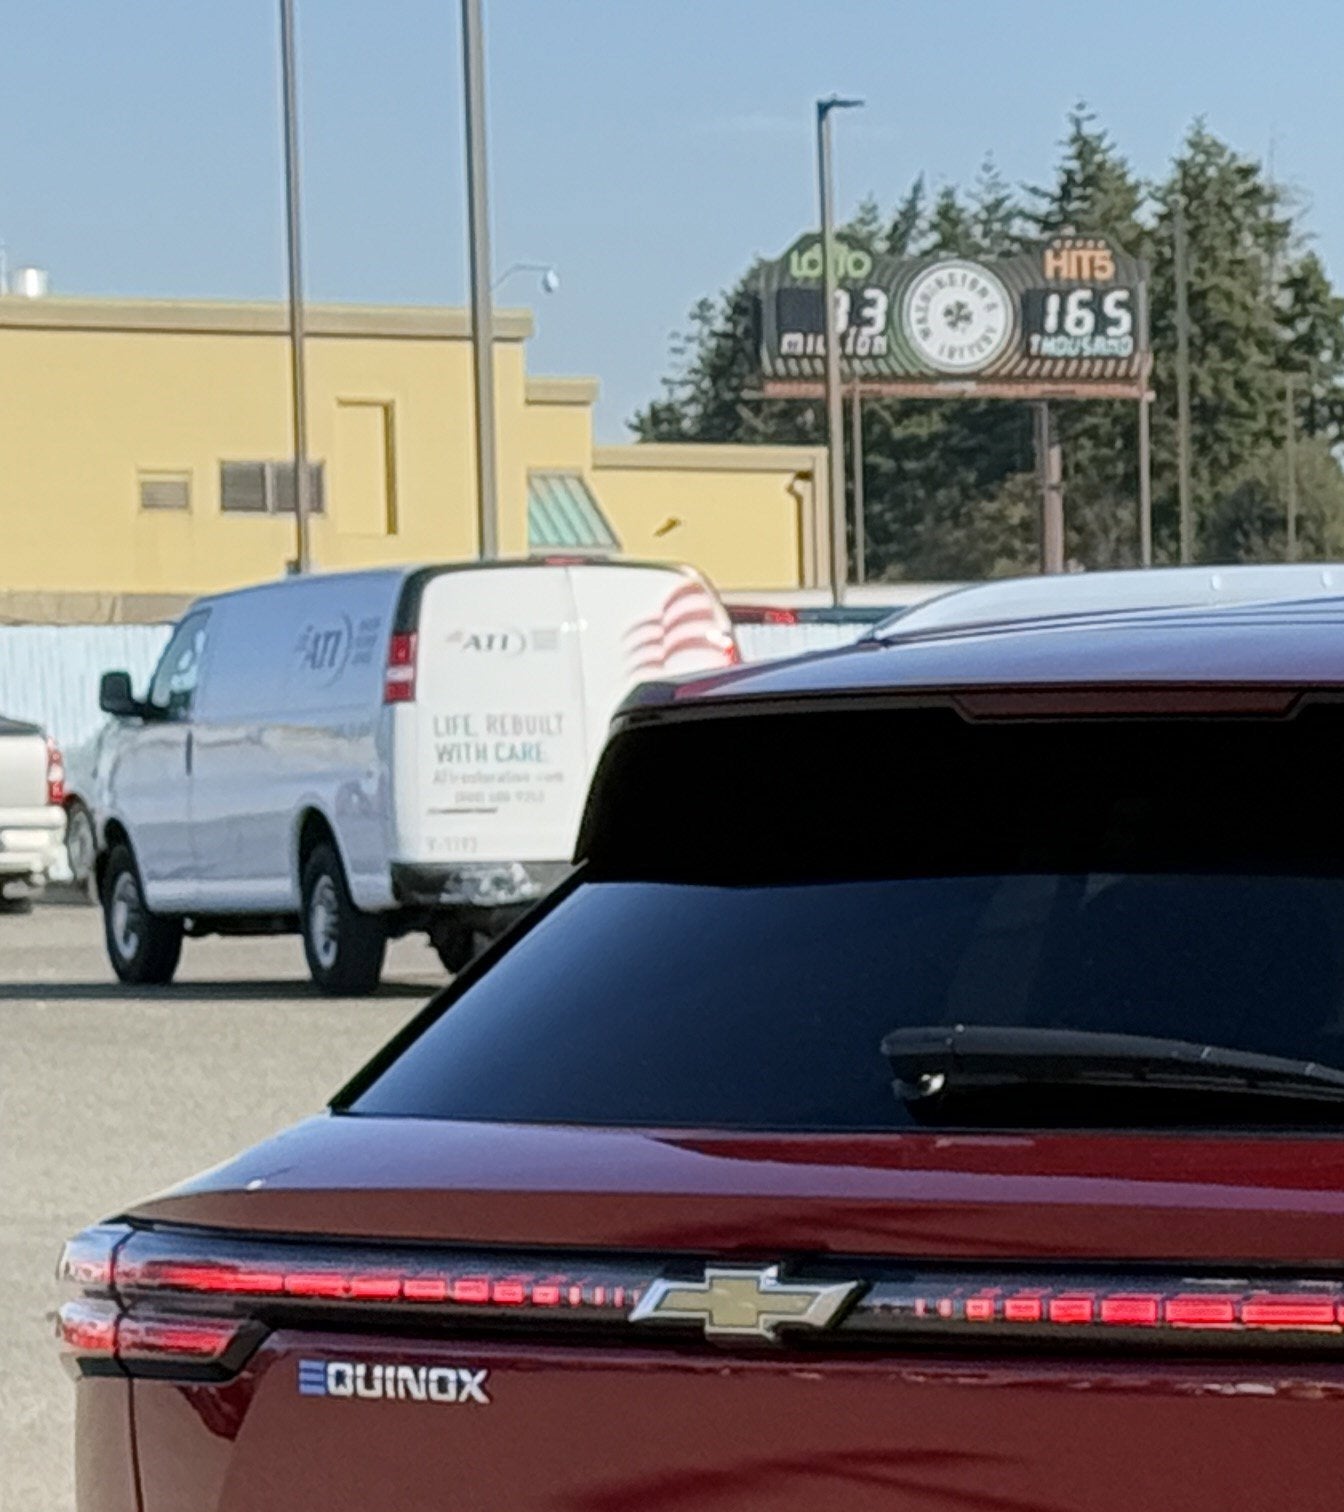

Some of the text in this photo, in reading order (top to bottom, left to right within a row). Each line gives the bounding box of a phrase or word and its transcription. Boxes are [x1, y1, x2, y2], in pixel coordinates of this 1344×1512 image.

[485, 713, 564, 738] REBUILT
[435, 742, 488, 764] WITH
[298, 1359, 491, 1404] EQUINOX
